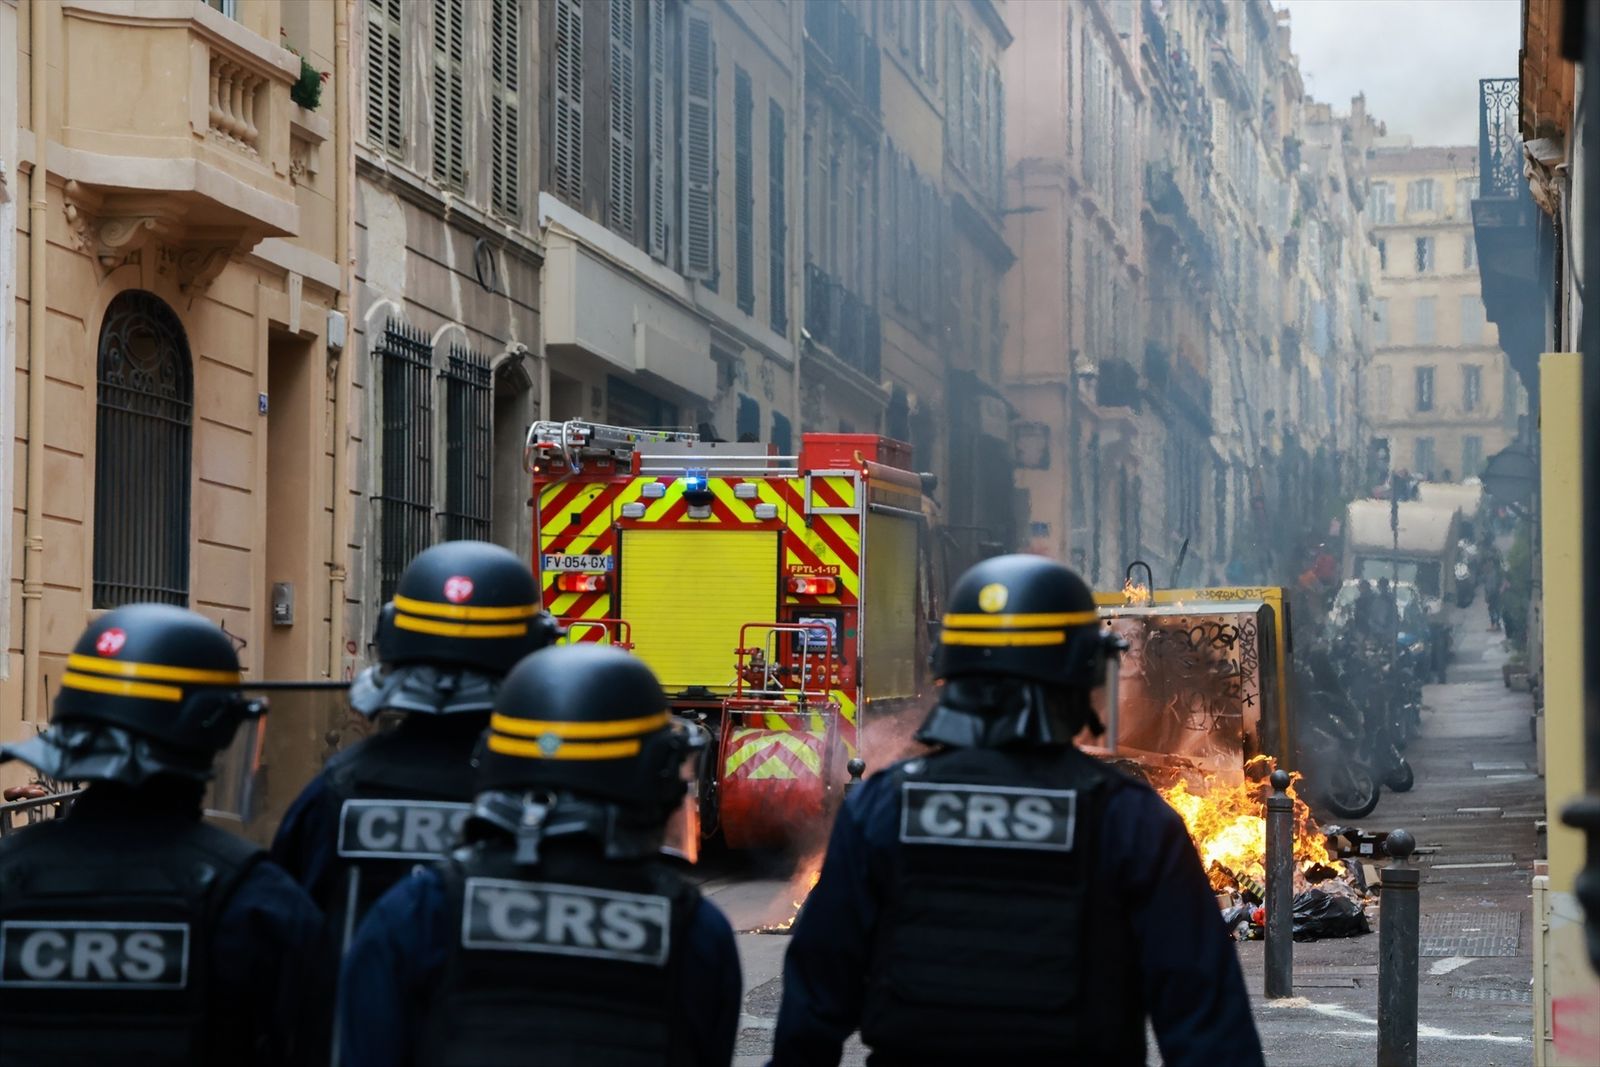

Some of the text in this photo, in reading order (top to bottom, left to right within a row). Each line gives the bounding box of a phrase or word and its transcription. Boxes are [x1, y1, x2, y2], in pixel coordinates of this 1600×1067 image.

[545, 556, 606, 569] FV-054-GX
[919, 792, 1054, 841] CRS
[487, 890, 647, 950] CRS
[20, 930, 166, 980] CRS
